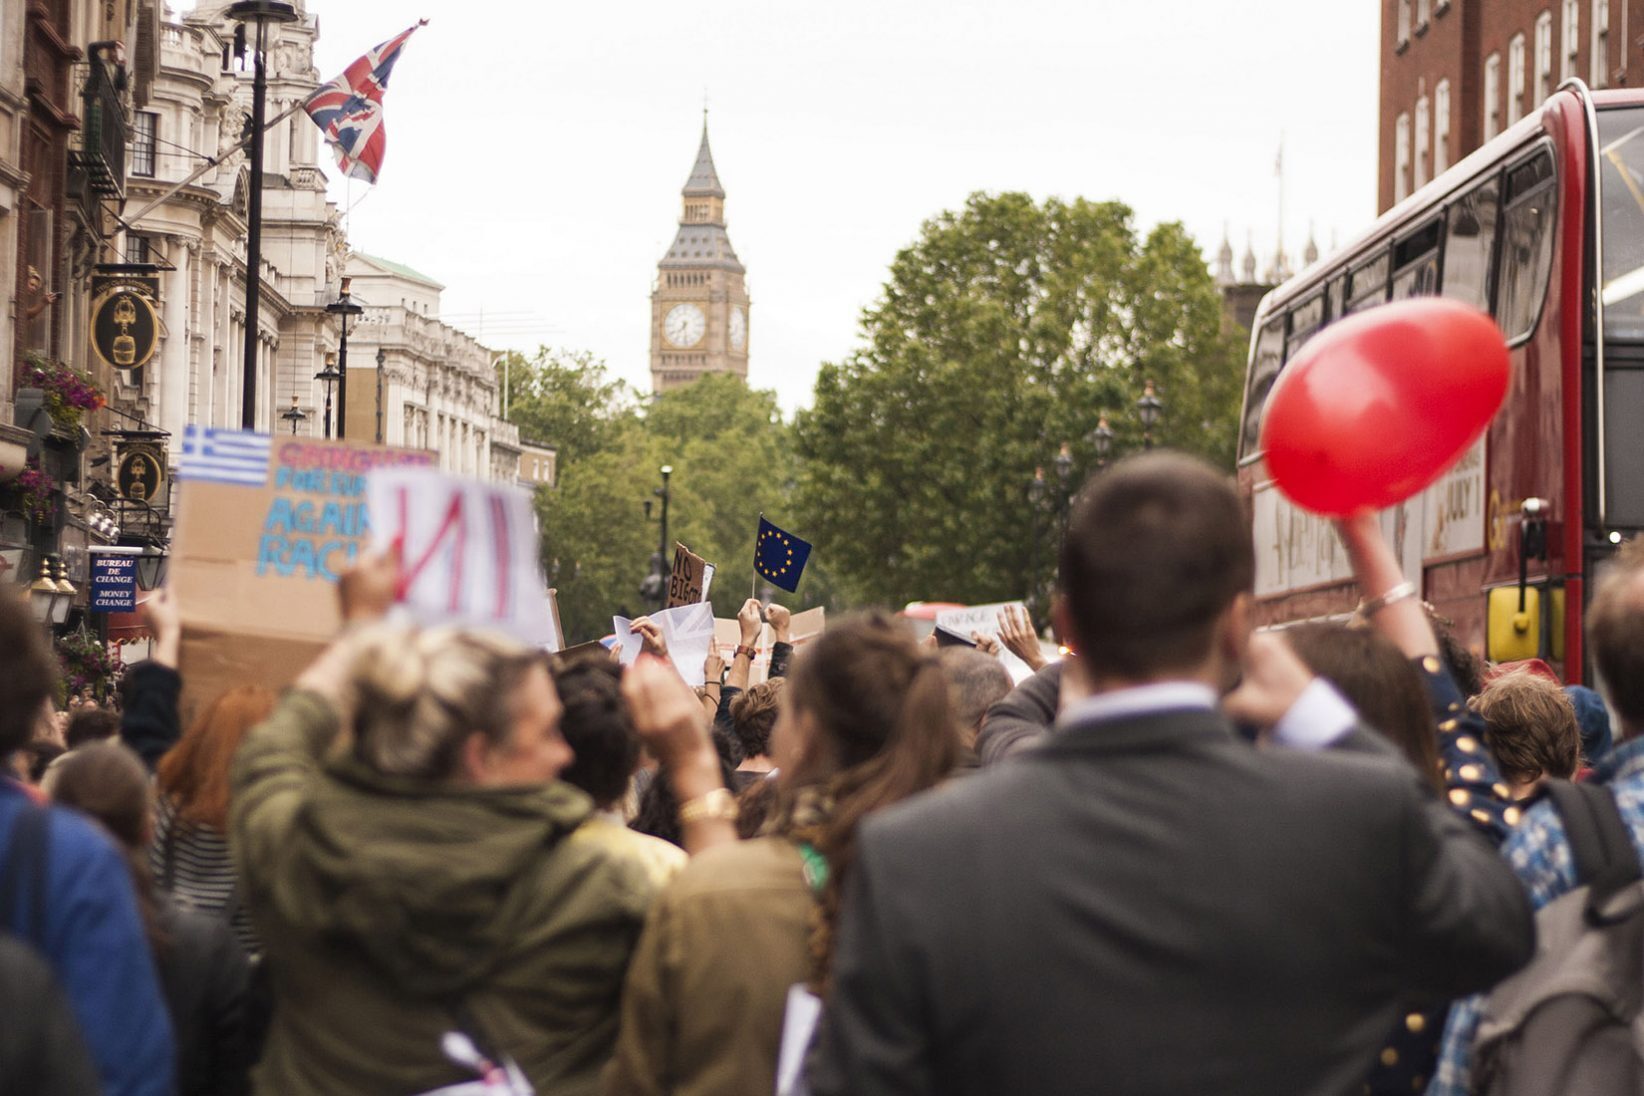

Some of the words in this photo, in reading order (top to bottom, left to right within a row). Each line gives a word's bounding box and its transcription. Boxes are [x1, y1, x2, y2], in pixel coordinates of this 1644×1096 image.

[96, 559, 134, 567] BUREAU
[672, 549, 692, 582] NO
[107, 567, 121, 575] DE
[95, 575, 134, 583] CHANGE
[99, 590, 132, 598] MONEY
[95, 598, 133, 607] CHANGE
